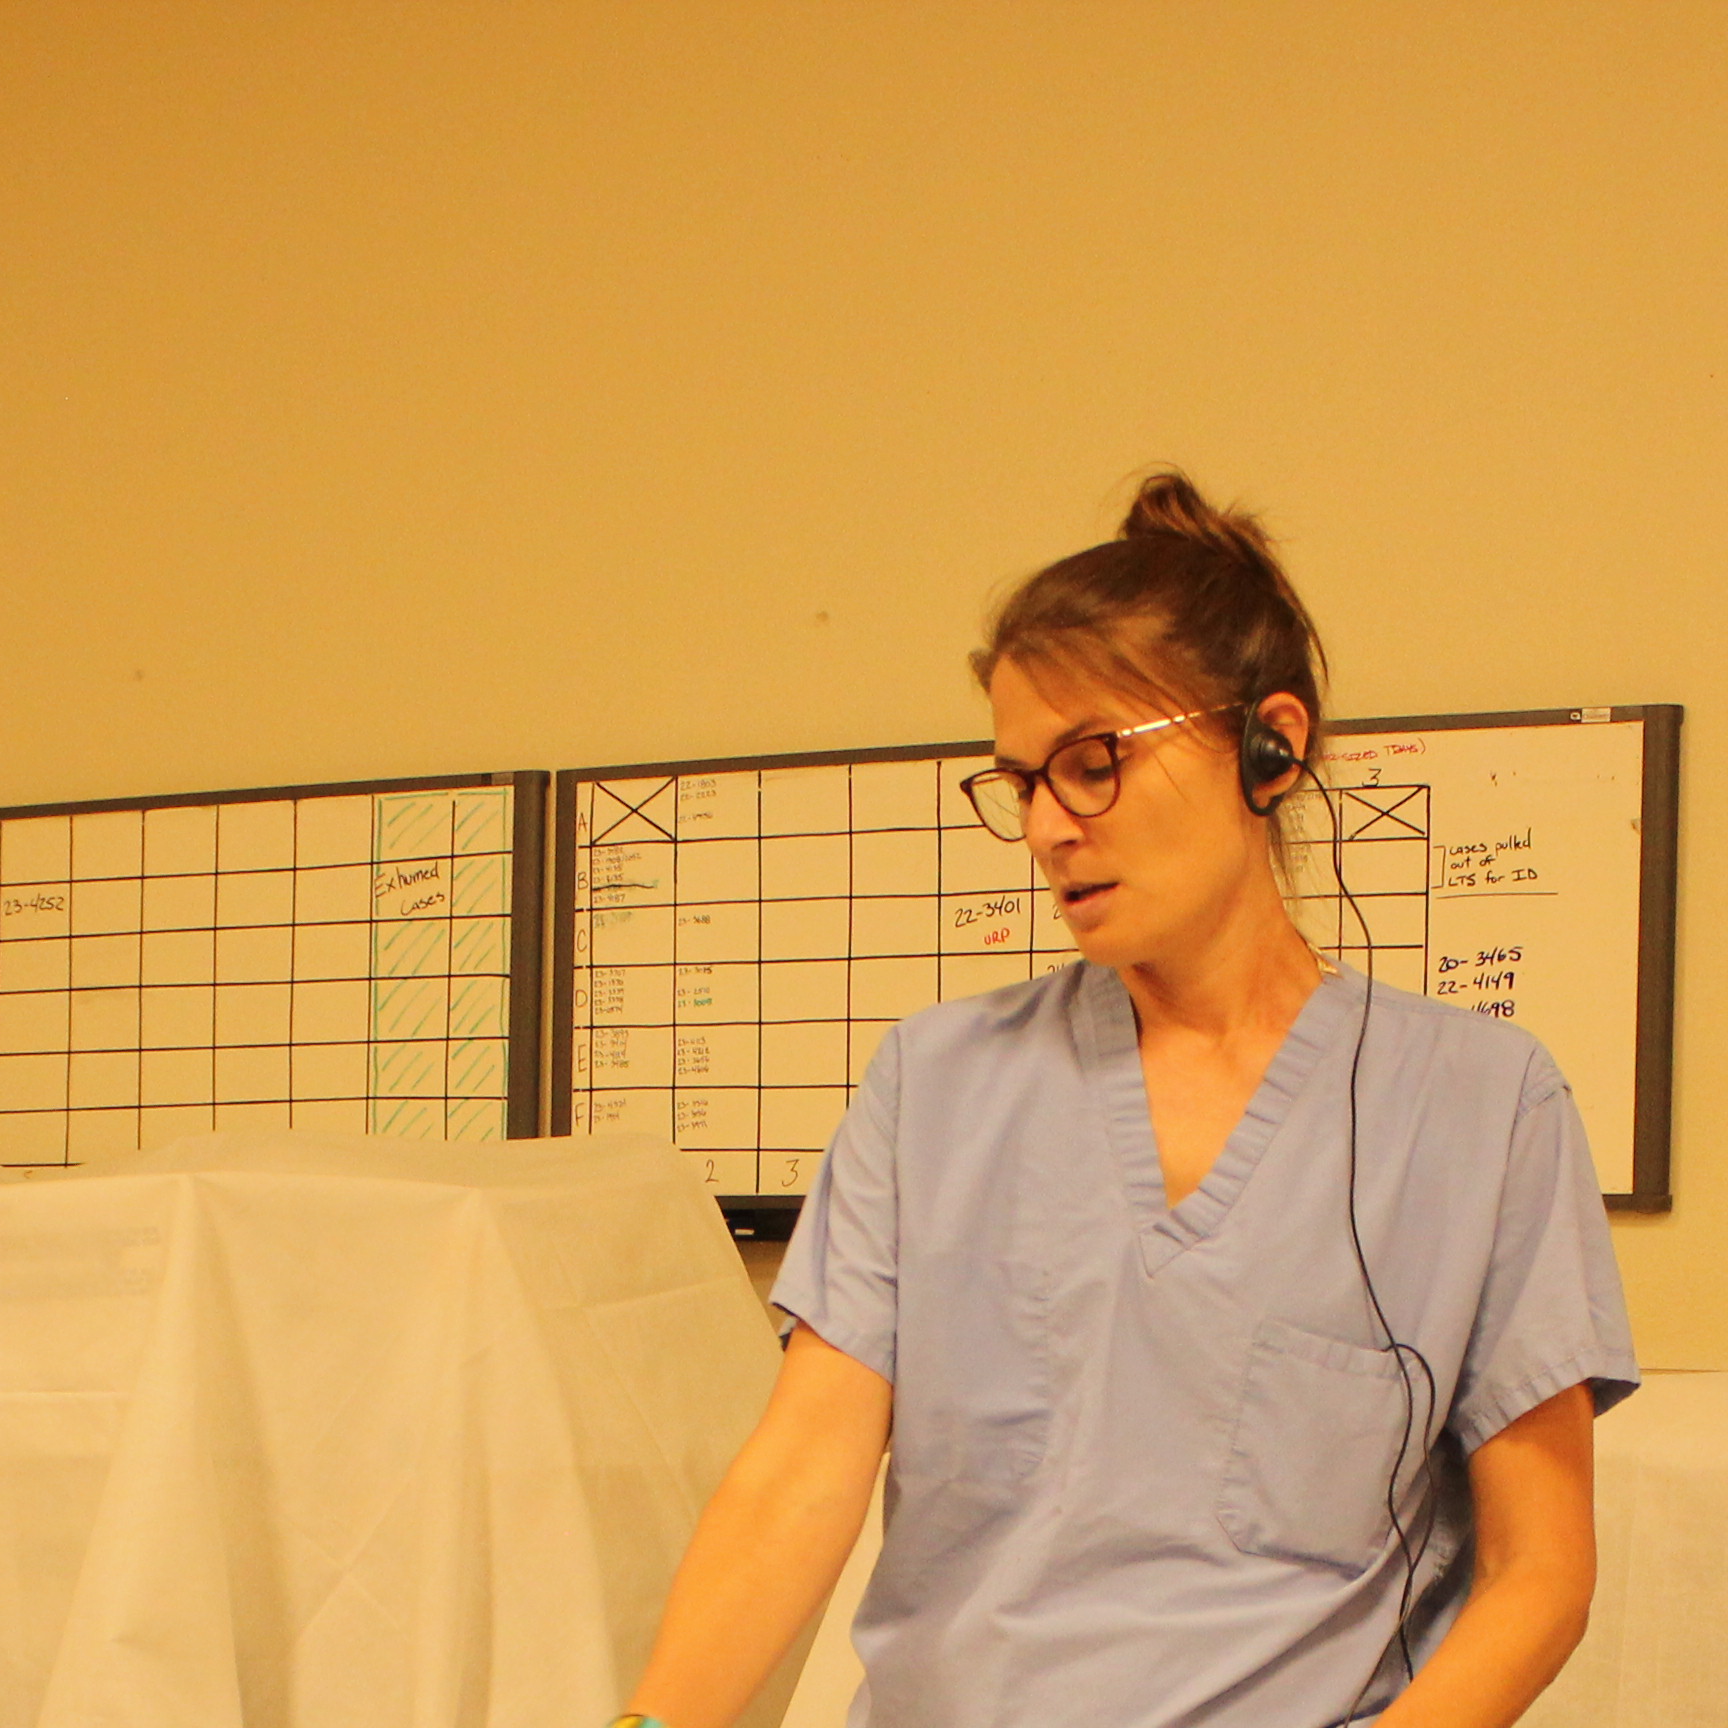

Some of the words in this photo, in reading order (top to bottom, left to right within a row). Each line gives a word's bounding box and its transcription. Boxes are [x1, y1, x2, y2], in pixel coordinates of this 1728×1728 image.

[577, 812, 589, 832] A
[374, 860, 440, 898] Exhumed
[577, 872, 589, 891] B
[1511, 868, 1538, 882] ID
[954, 895, 1021, 928] 22-3401
[576, 929, 588, 953] C
[575, 989, 588, 1008] D
[577, 1044, 587, 1073] E
[704, 1158, 720, 1183] 2
[780, 1159, 800, 1187] 3
